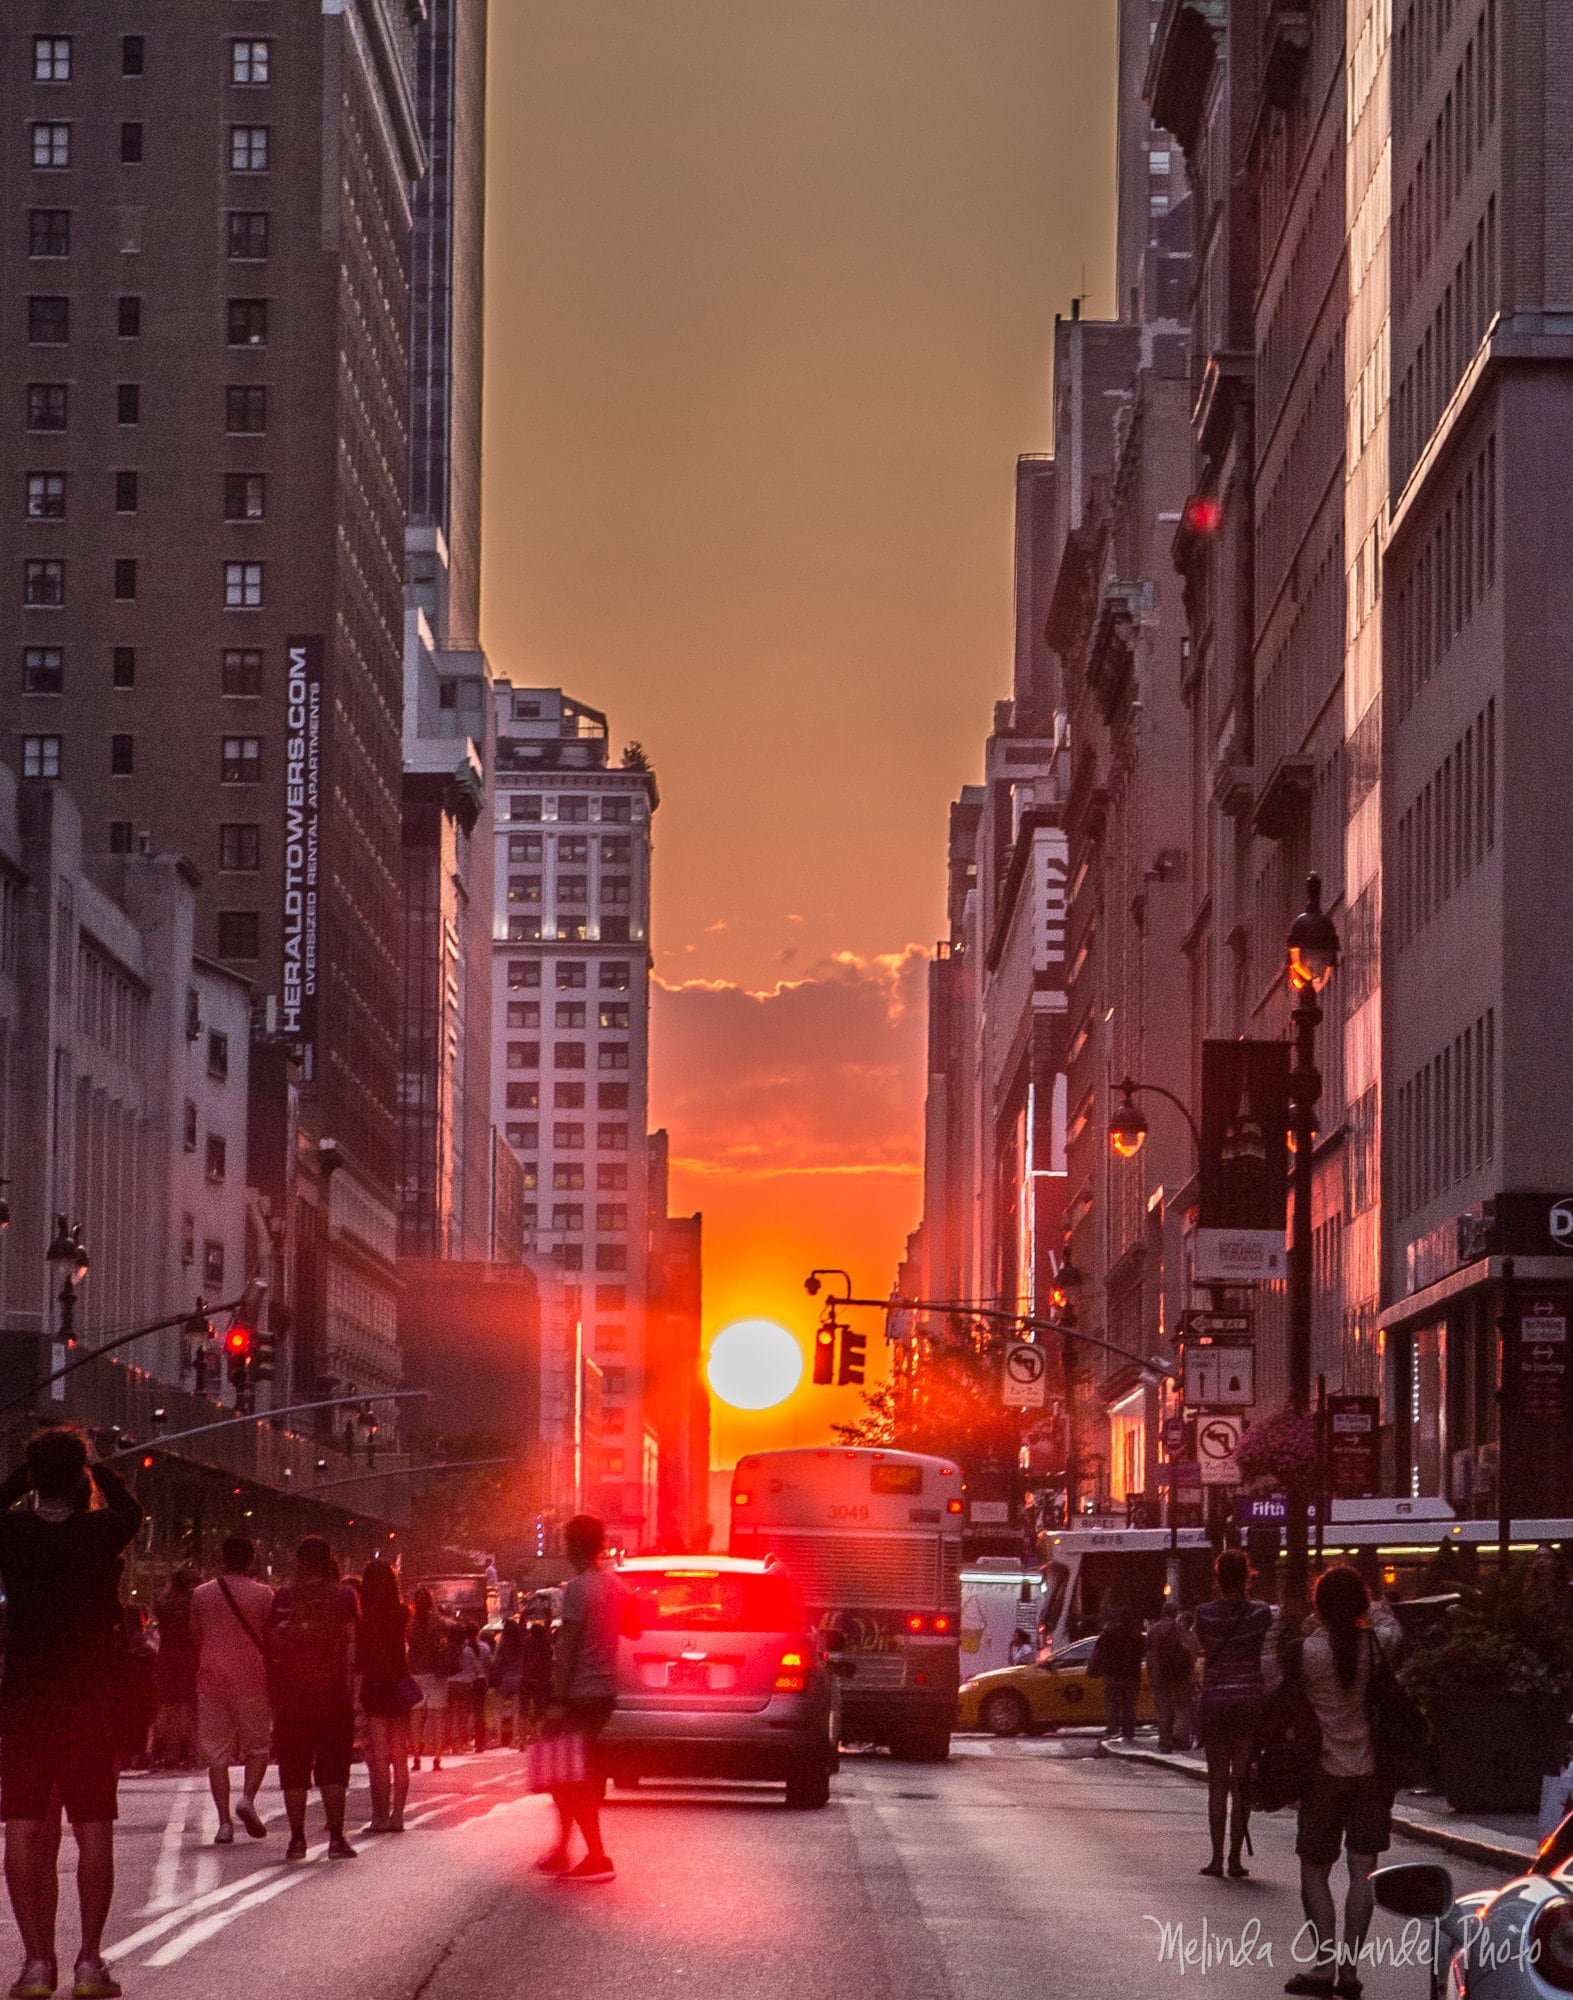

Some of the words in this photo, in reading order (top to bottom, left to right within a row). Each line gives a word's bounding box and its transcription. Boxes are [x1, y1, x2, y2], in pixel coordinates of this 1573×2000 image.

[307, 682, 320, 808] APARTMENTS
[283, 647, 306, 1032] HERALDTOWERS.COM
[307, 813, 318, 885] RENTAL
[305, 891, 317, 995] OVERSIZED
[827, 1504, 869, 1521] 3049
[1252, 1500, 1285, 1516] Fifth
